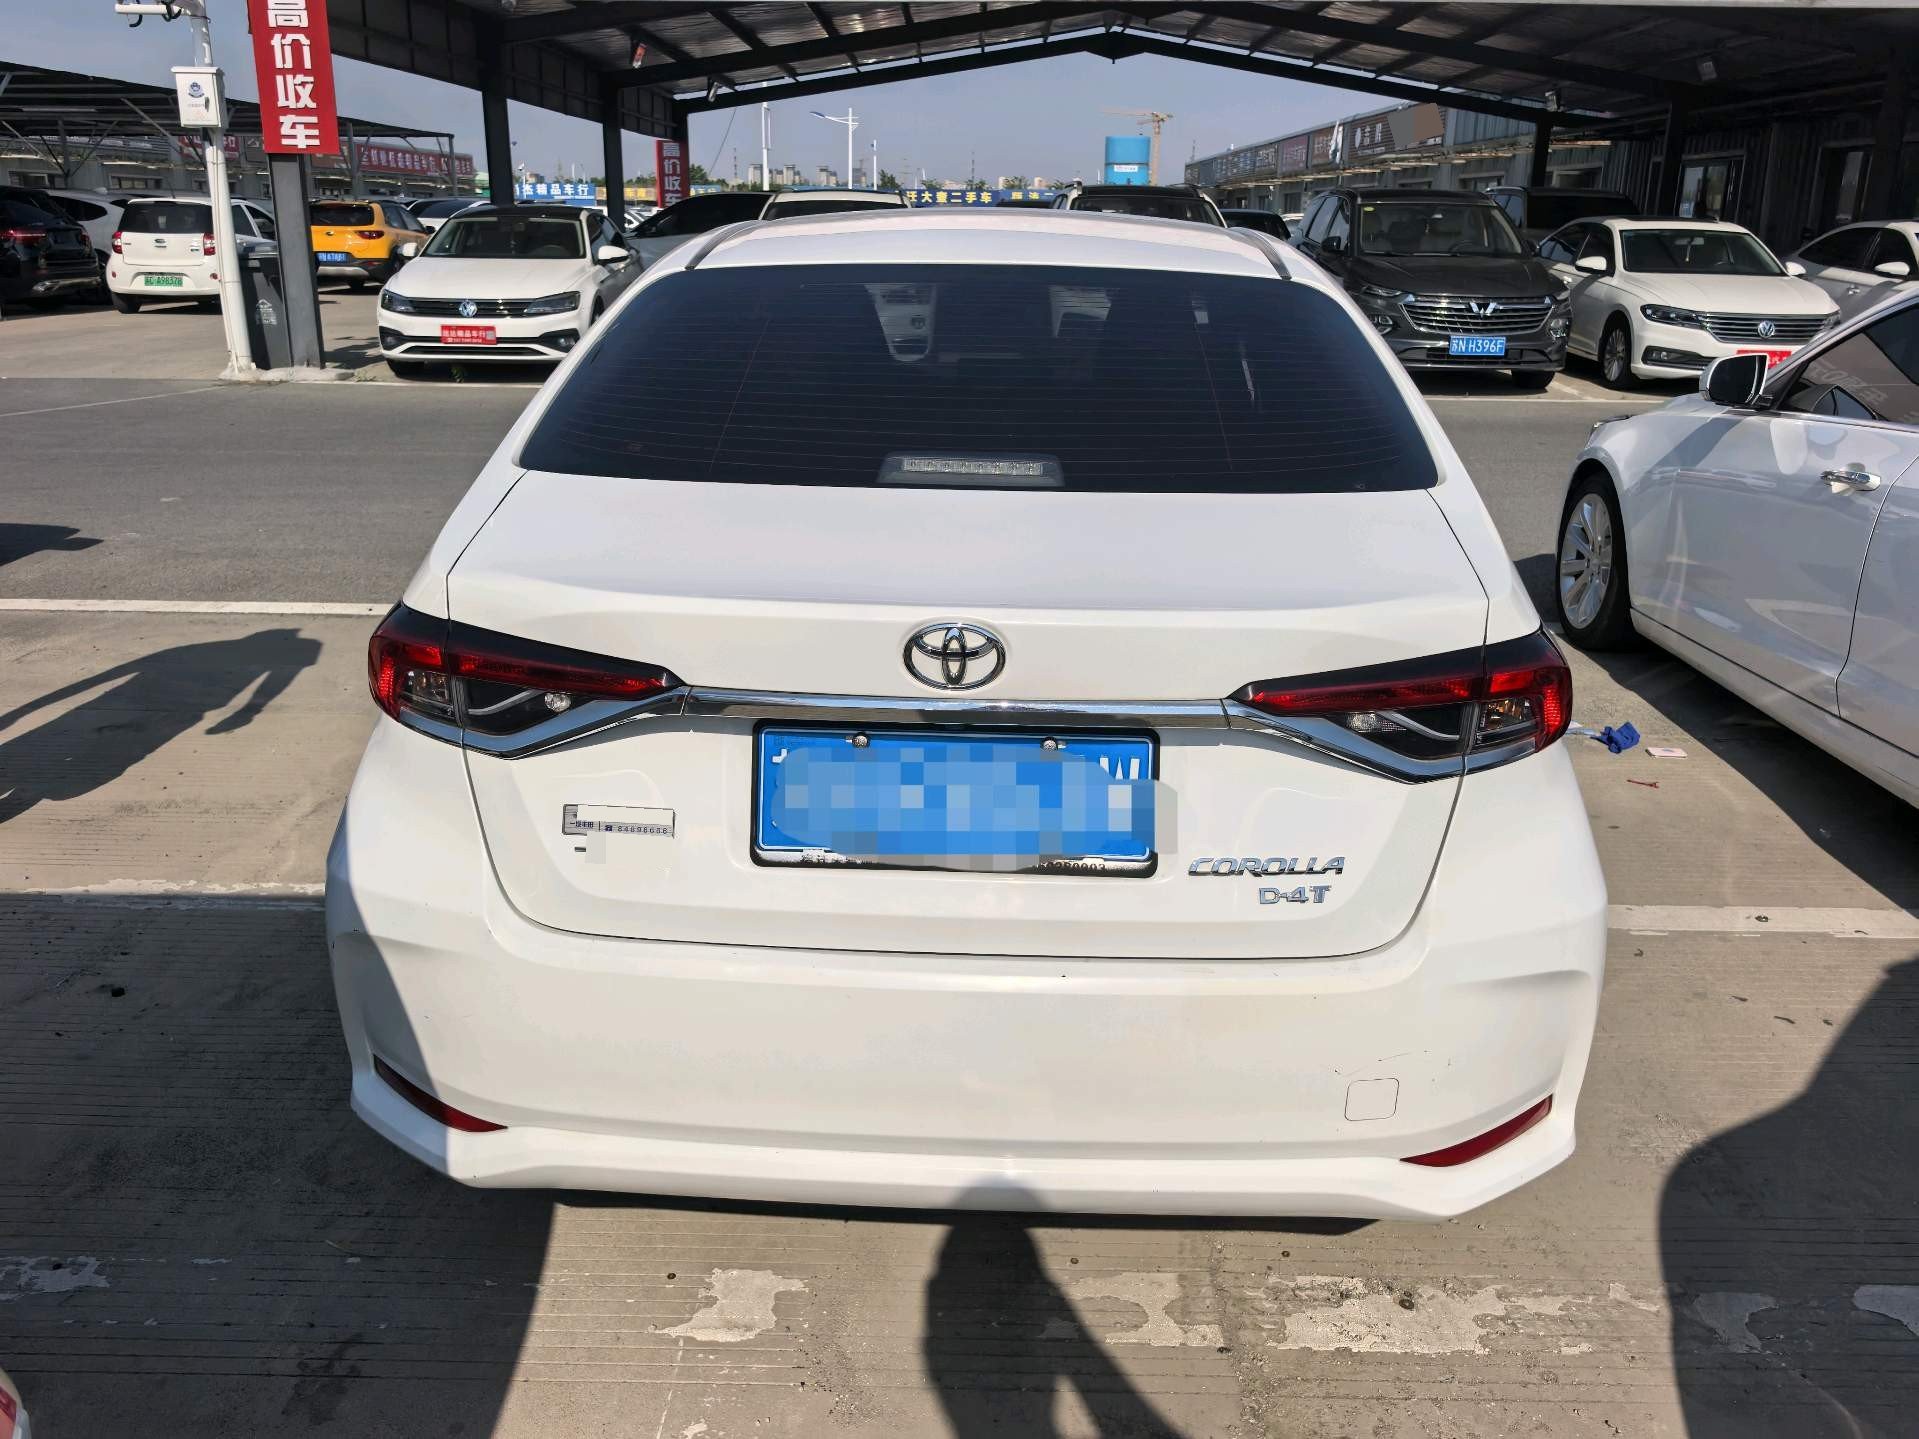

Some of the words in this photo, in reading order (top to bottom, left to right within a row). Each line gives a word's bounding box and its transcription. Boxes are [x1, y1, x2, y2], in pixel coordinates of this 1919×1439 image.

[266, 0, 321, 149] 高价收车
[1188, 856, 1345, 877] COROLLA
